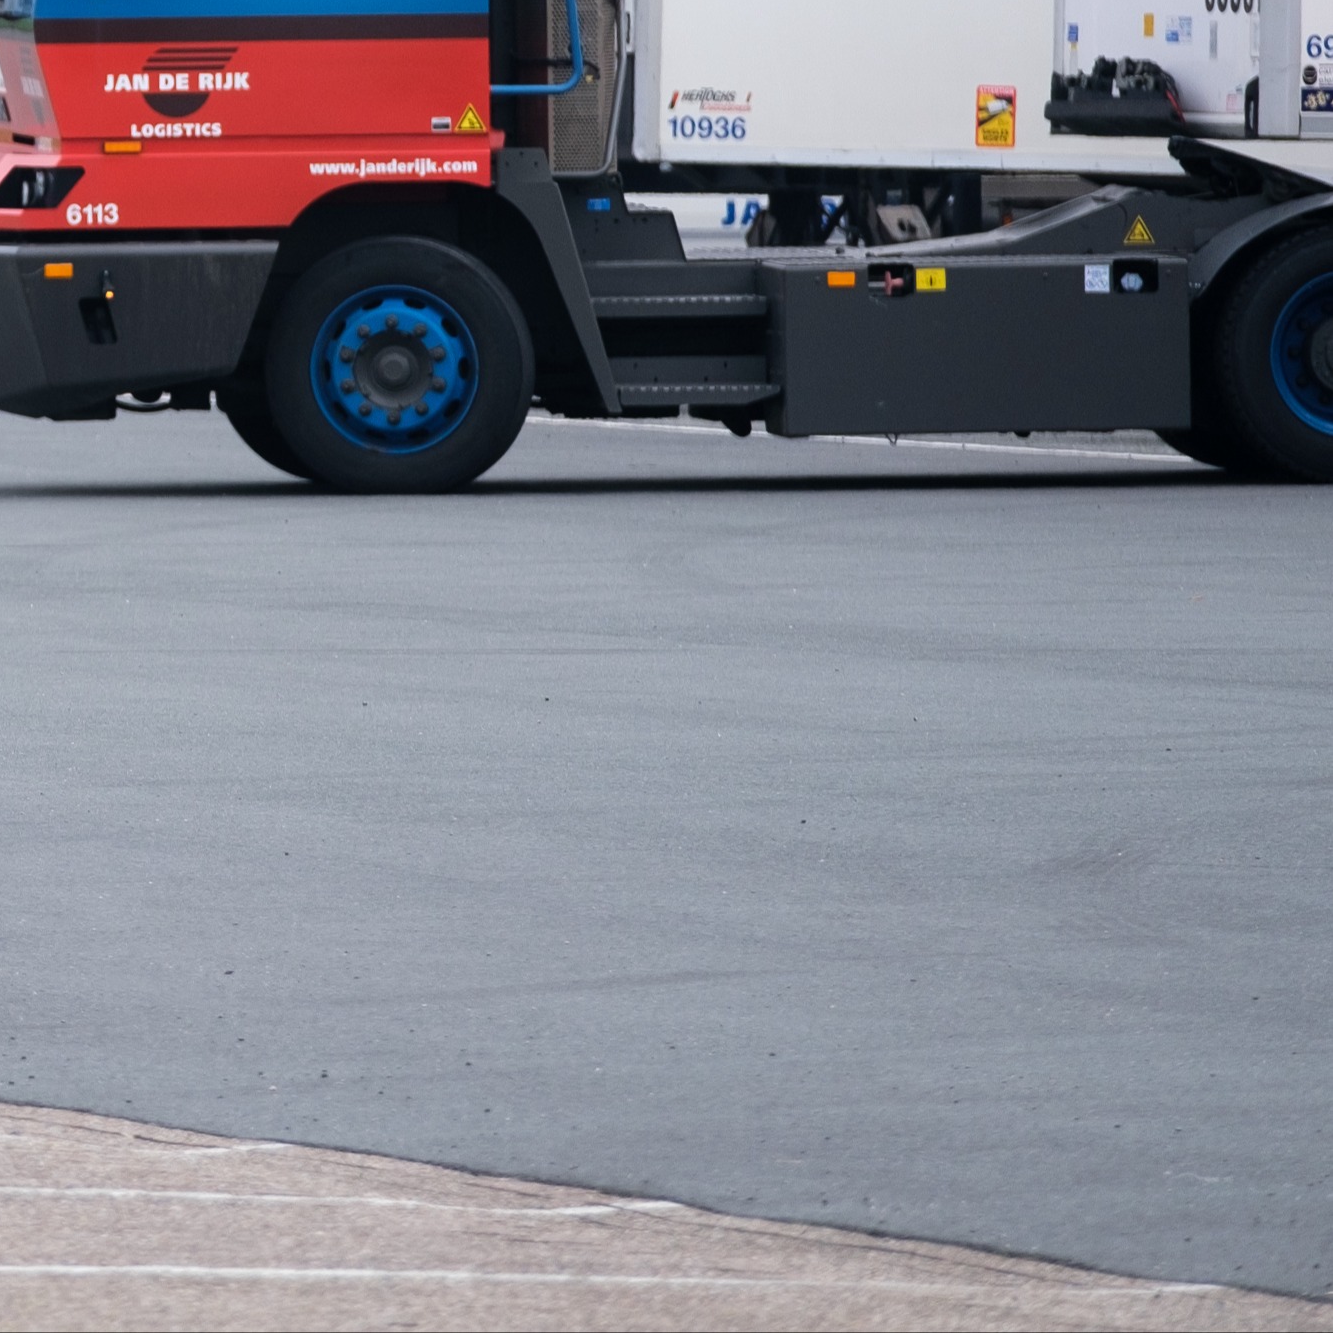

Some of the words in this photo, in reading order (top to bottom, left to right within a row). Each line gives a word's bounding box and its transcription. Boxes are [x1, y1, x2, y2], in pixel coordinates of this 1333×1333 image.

[104, 73, 149, 92] JAN
[158, 72, 189, 91] DE
[198, 71, 250, 91] RIJK
[131, 122, 222, 138] LOGISTICS
[668, 116, 746, 140] 10936
[309, 158, 478, 178] www.janderijk.com
[66, 202, 119, 226] 6113
